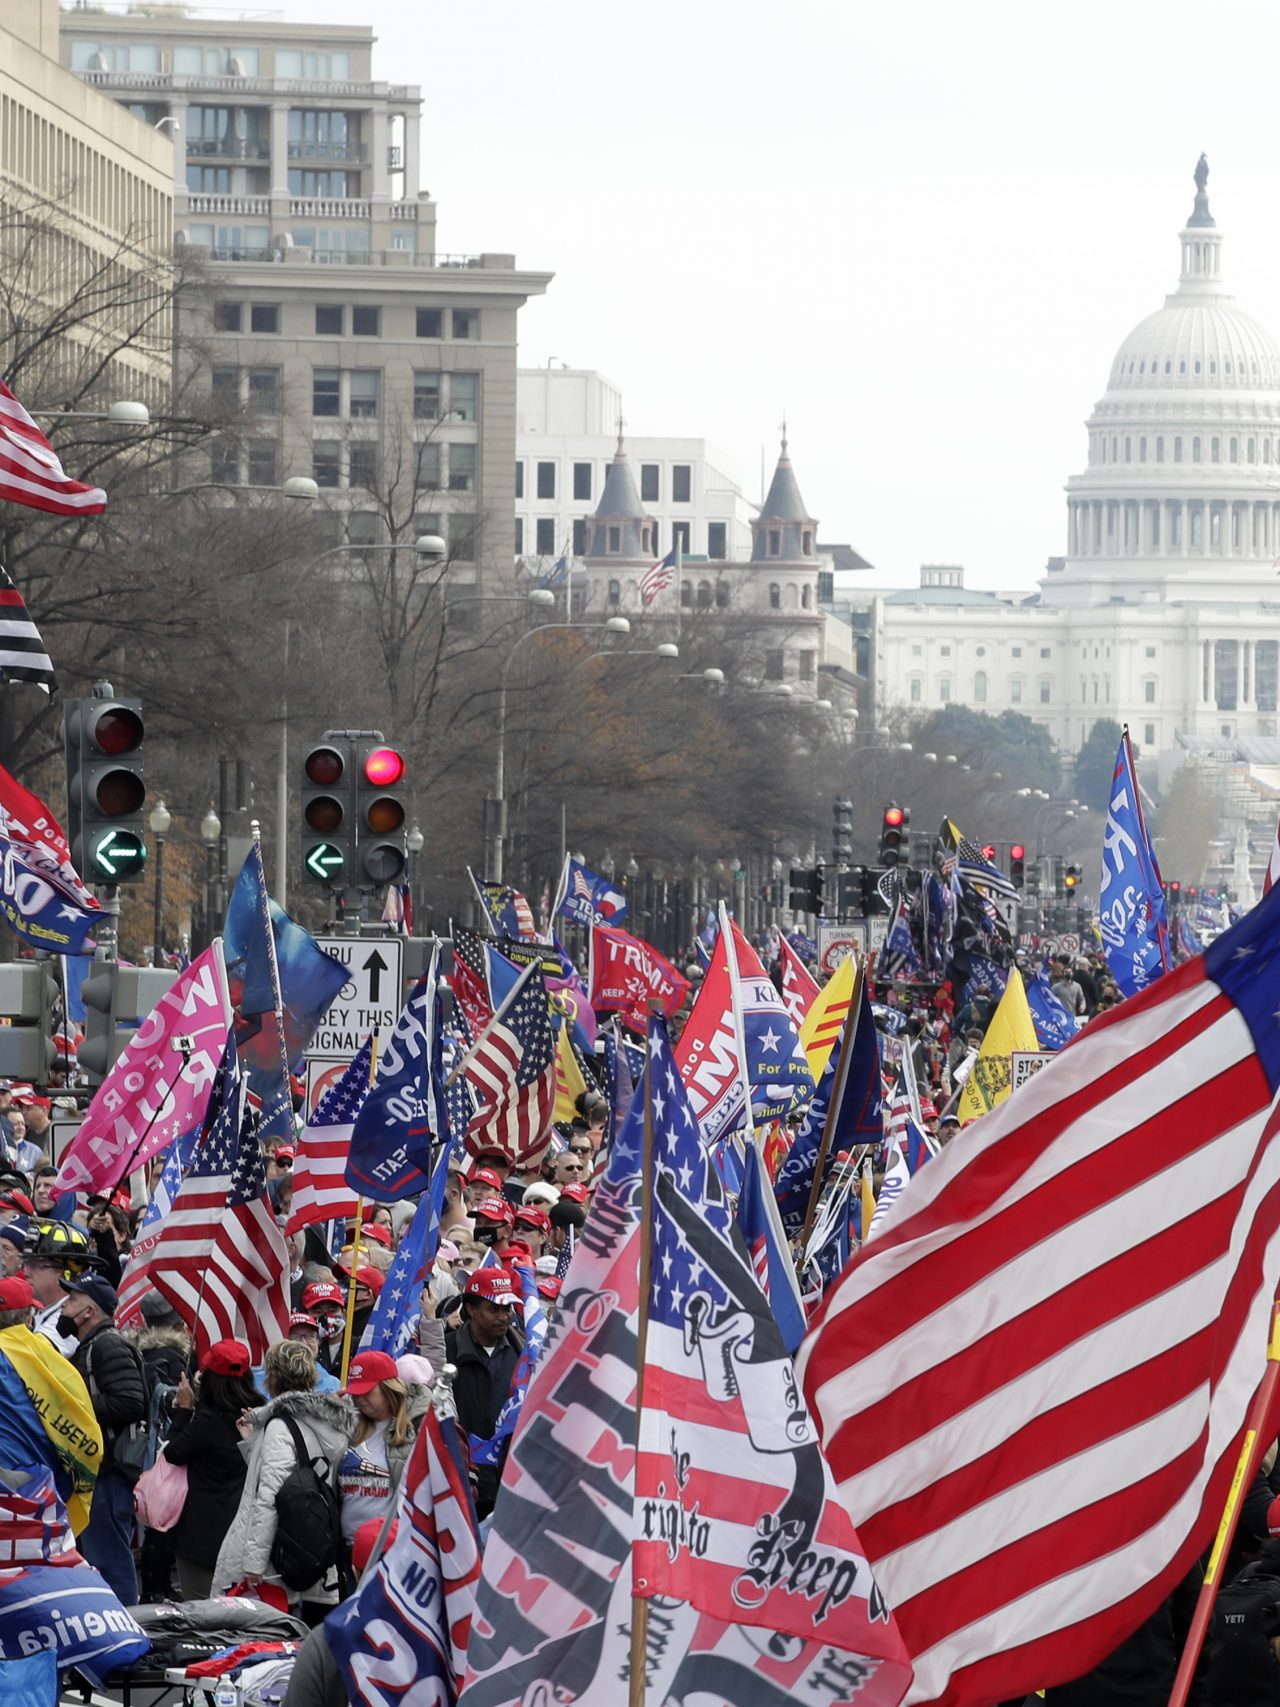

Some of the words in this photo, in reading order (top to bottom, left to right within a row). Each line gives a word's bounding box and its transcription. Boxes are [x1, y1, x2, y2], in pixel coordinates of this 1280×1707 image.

[828, 931, 856, 940] TURNING
[605, 938, 675, 997] TRUMP
[318, 1009, 350, 1027] BEY
[357, 1009, 393, 1027] THIS
[308, 1031, 361, 1050] SIGNAL
[758, 1063, 781, 1075] For
[312, 1284, 335, 1293] TRUMP
[470, 1283, 480, 1293] 45
[374, 1478, 390, 1488] THE
[400, 1560, 438, 1609] NO
[1224, 1614, 1246, 1624] YETI
